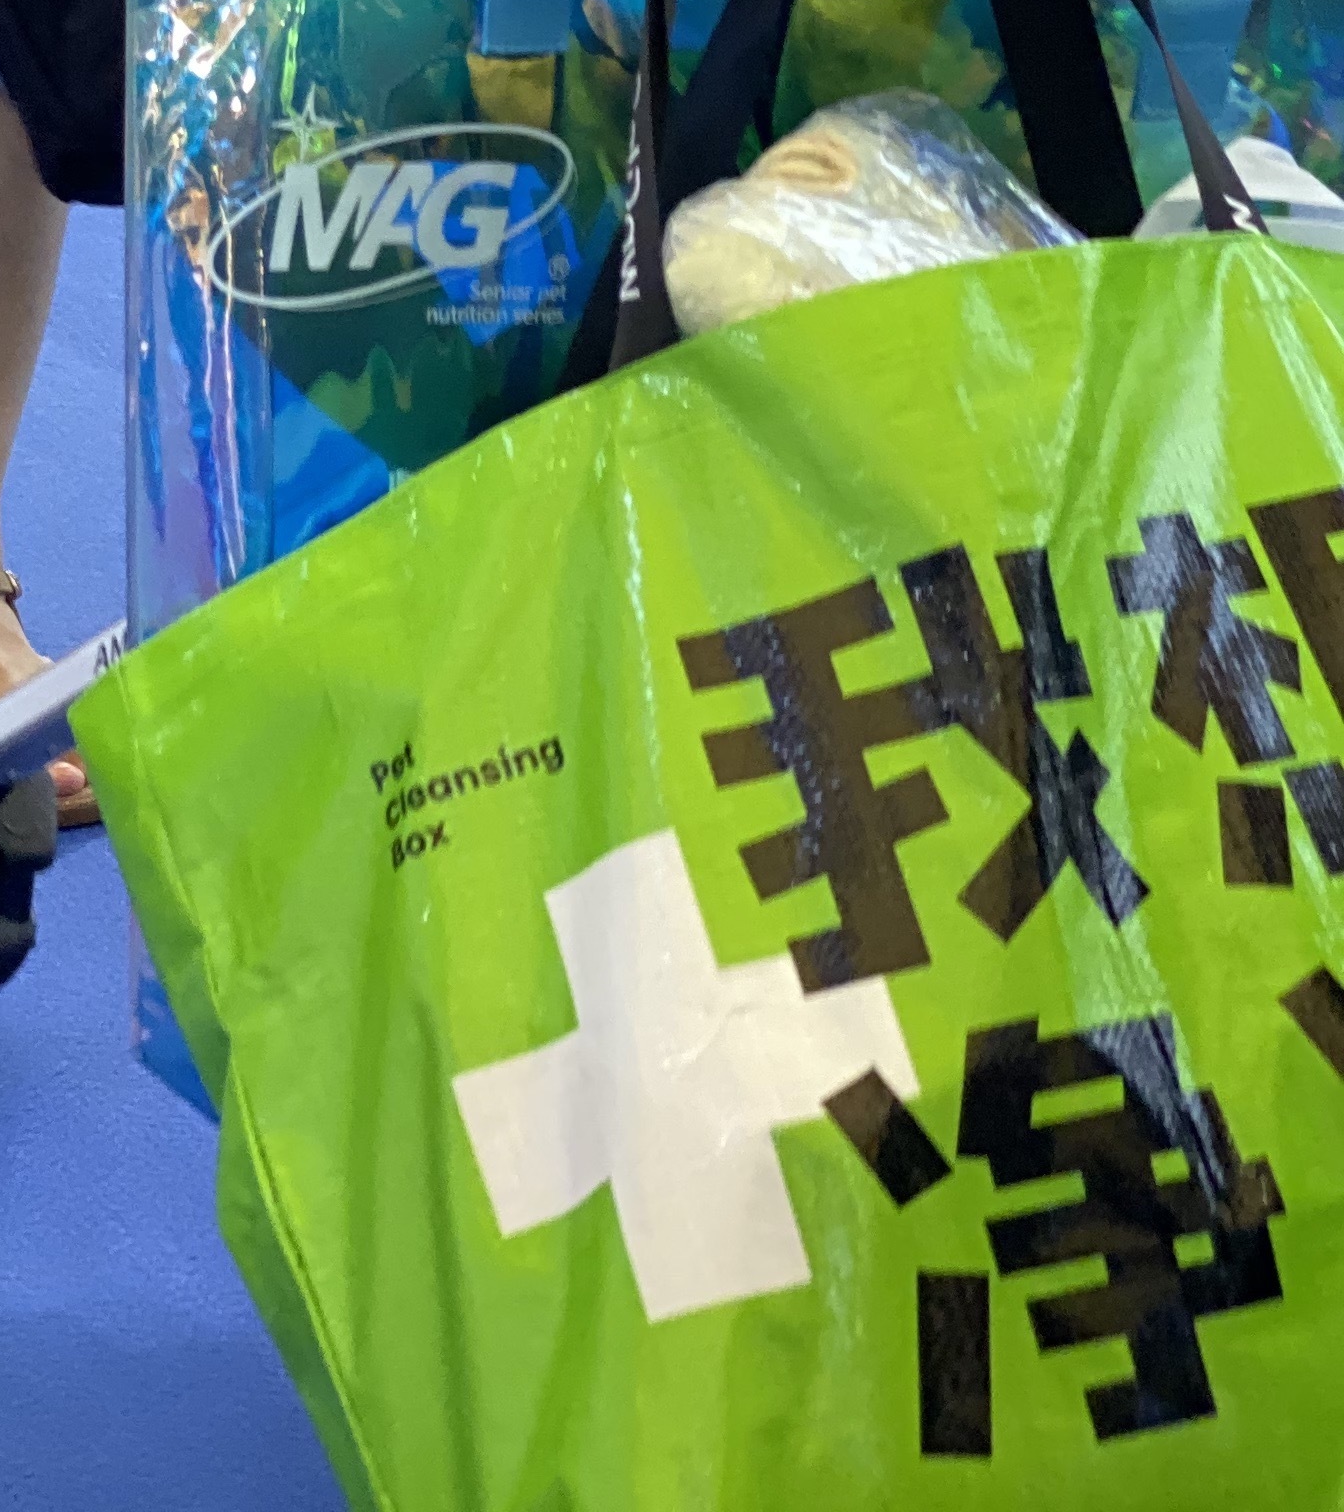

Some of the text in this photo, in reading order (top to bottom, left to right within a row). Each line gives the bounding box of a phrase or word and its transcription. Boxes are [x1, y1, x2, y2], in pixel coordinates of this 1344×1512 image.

[269, 160, 517, 273] MAG
[426, 304, 508, 325] nutrition
[369, 739, 415, 796] Pet
